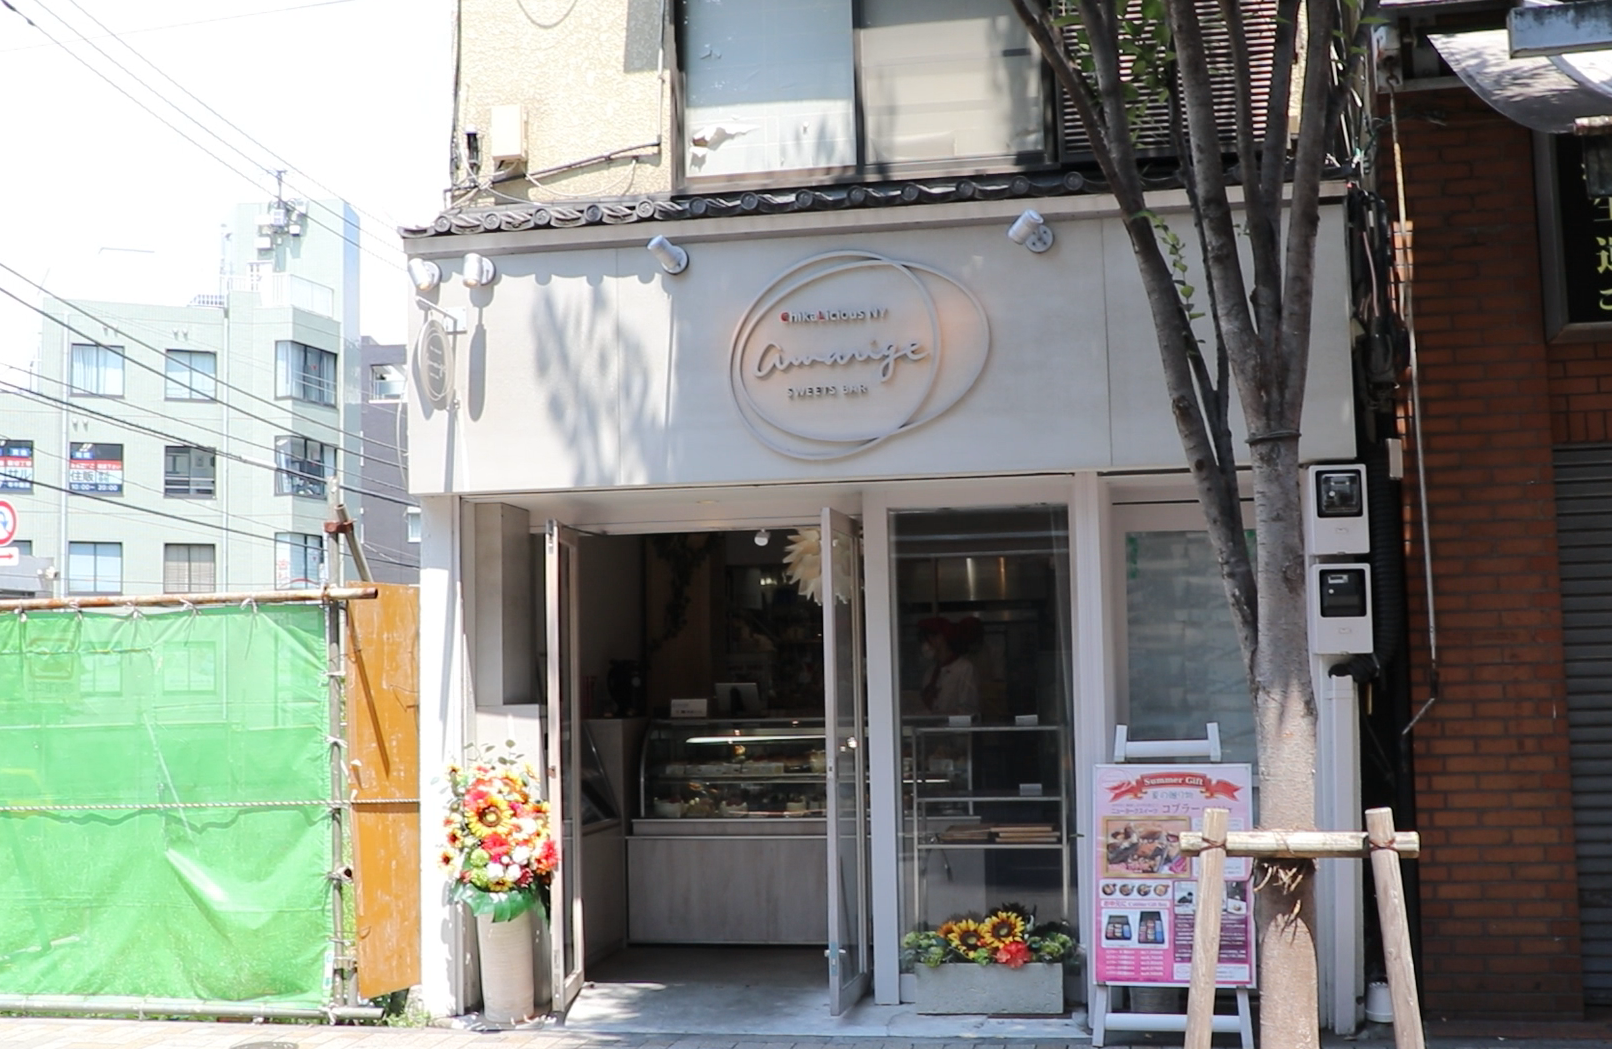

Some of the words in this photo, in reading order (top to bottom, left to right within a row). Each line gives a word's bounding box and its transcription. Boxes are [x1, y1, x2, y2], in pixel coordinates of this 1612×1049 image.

[780, 309, 865, 324] ChikaLicious
[869, 308, 888, 321] NY
[786, 385, 836, 400] SWEETS
[843, 384, 868, 396] BAR
[1144, 777, 1182, 786] Summer
[1185, 776, 1203, 785] Gift
[1162, 804, 1200, 814] コブラー
